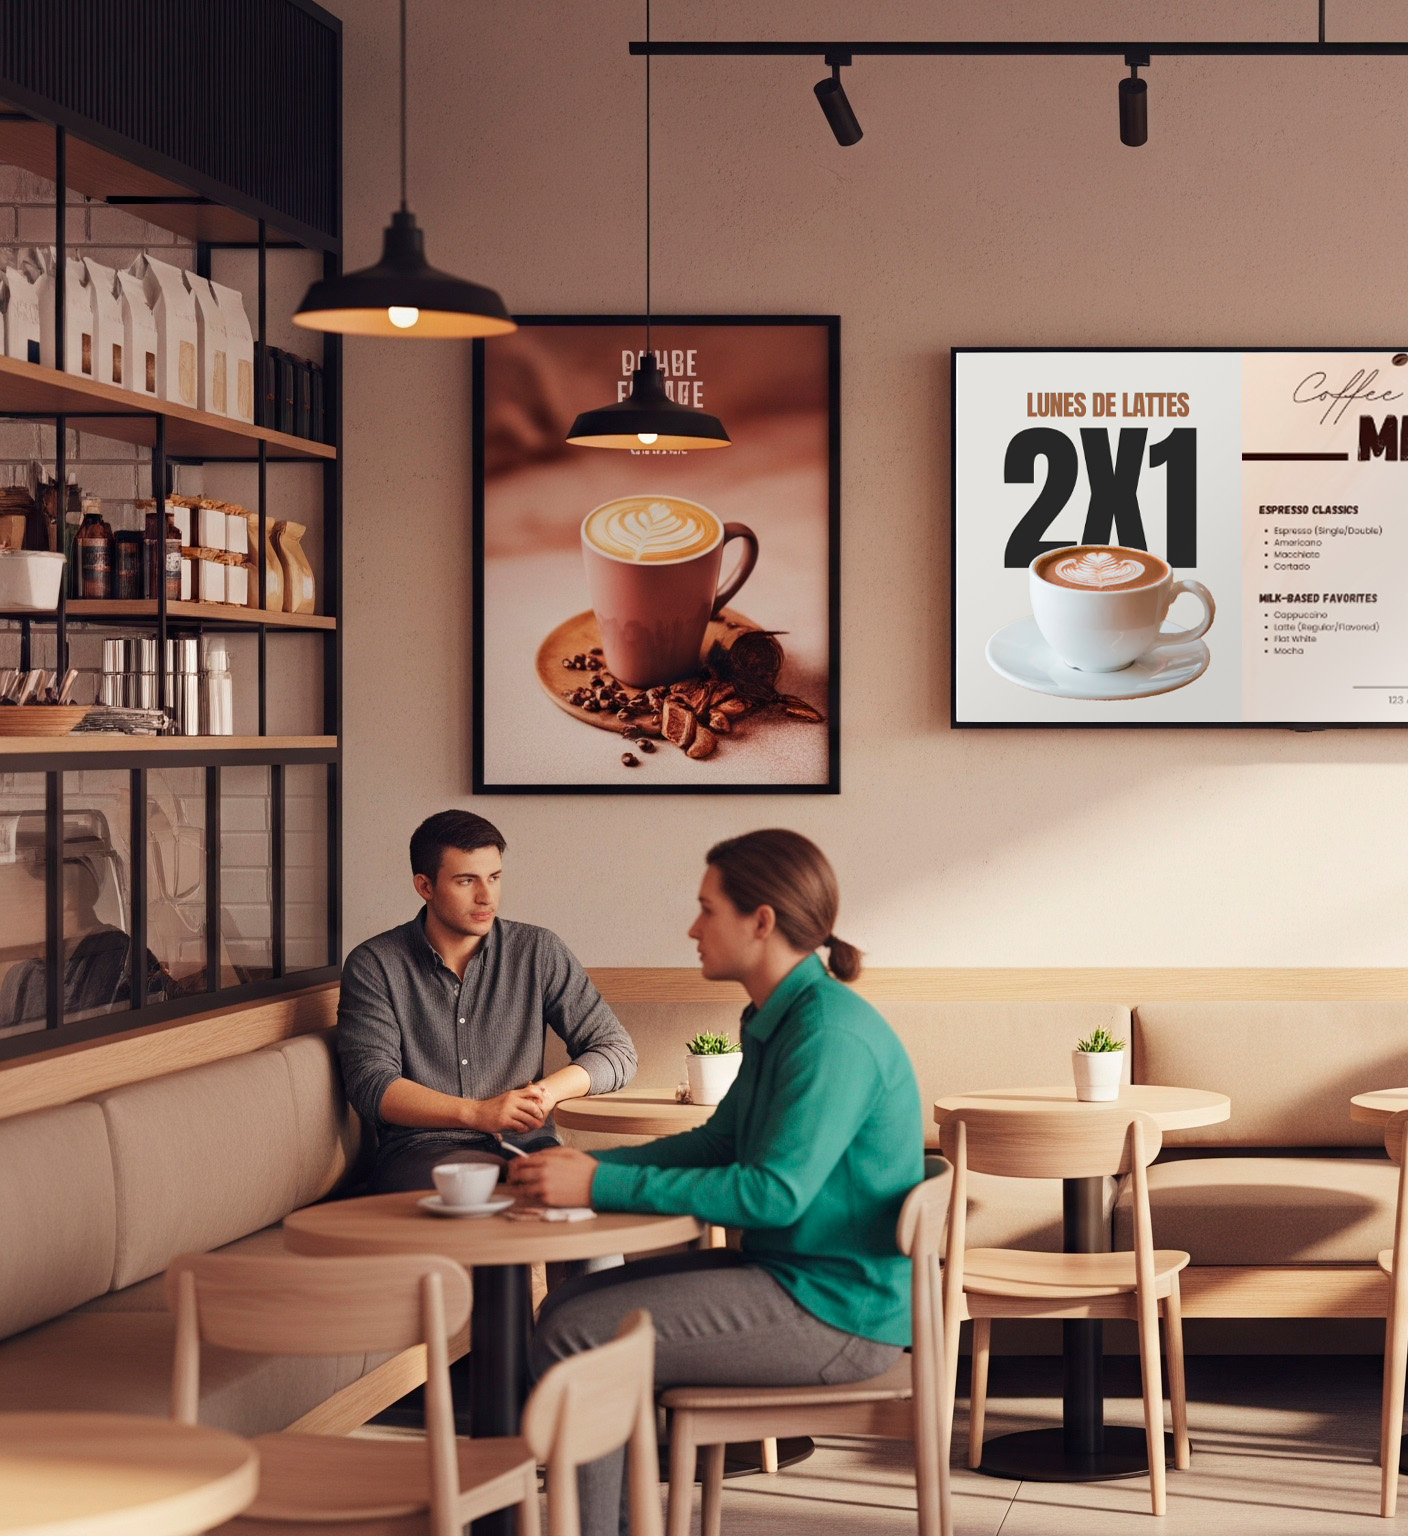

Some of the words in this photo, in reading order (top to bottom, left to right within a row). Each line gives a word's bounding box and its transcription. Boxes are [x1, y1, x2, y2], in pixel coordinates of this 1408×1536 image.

[1293, 369, 1403, 425] Coffee
[1027, 392, 1086, 418] LUNES
[1093, 392, 1116, 418] DE
[1122, 392, 1190, 418] LATTES
[1003, 427, 1198, 568] 2X1
[1259, 505, 1309, 515] ESPRESSO
[1312, 505, 1359, 515] CLASSICS
[1274, 527, 1312, 536] Espresso
[1314, 526, 1383, 537] (Single/Double)
[1274, 539, 1322, 547] Americano
[1274, 563, 1310, 571] Cortado
[1259, 593, 1320, 604] MILK-BASED
[1323, 593, 1378, 604] FAVORITES
[1274, 635, 1290, 643] Flat
[1291, 635, 1317, 643] White
[1274, 647, 1304, 655] Mocha
[1388, 695, 1404, 705] 123
